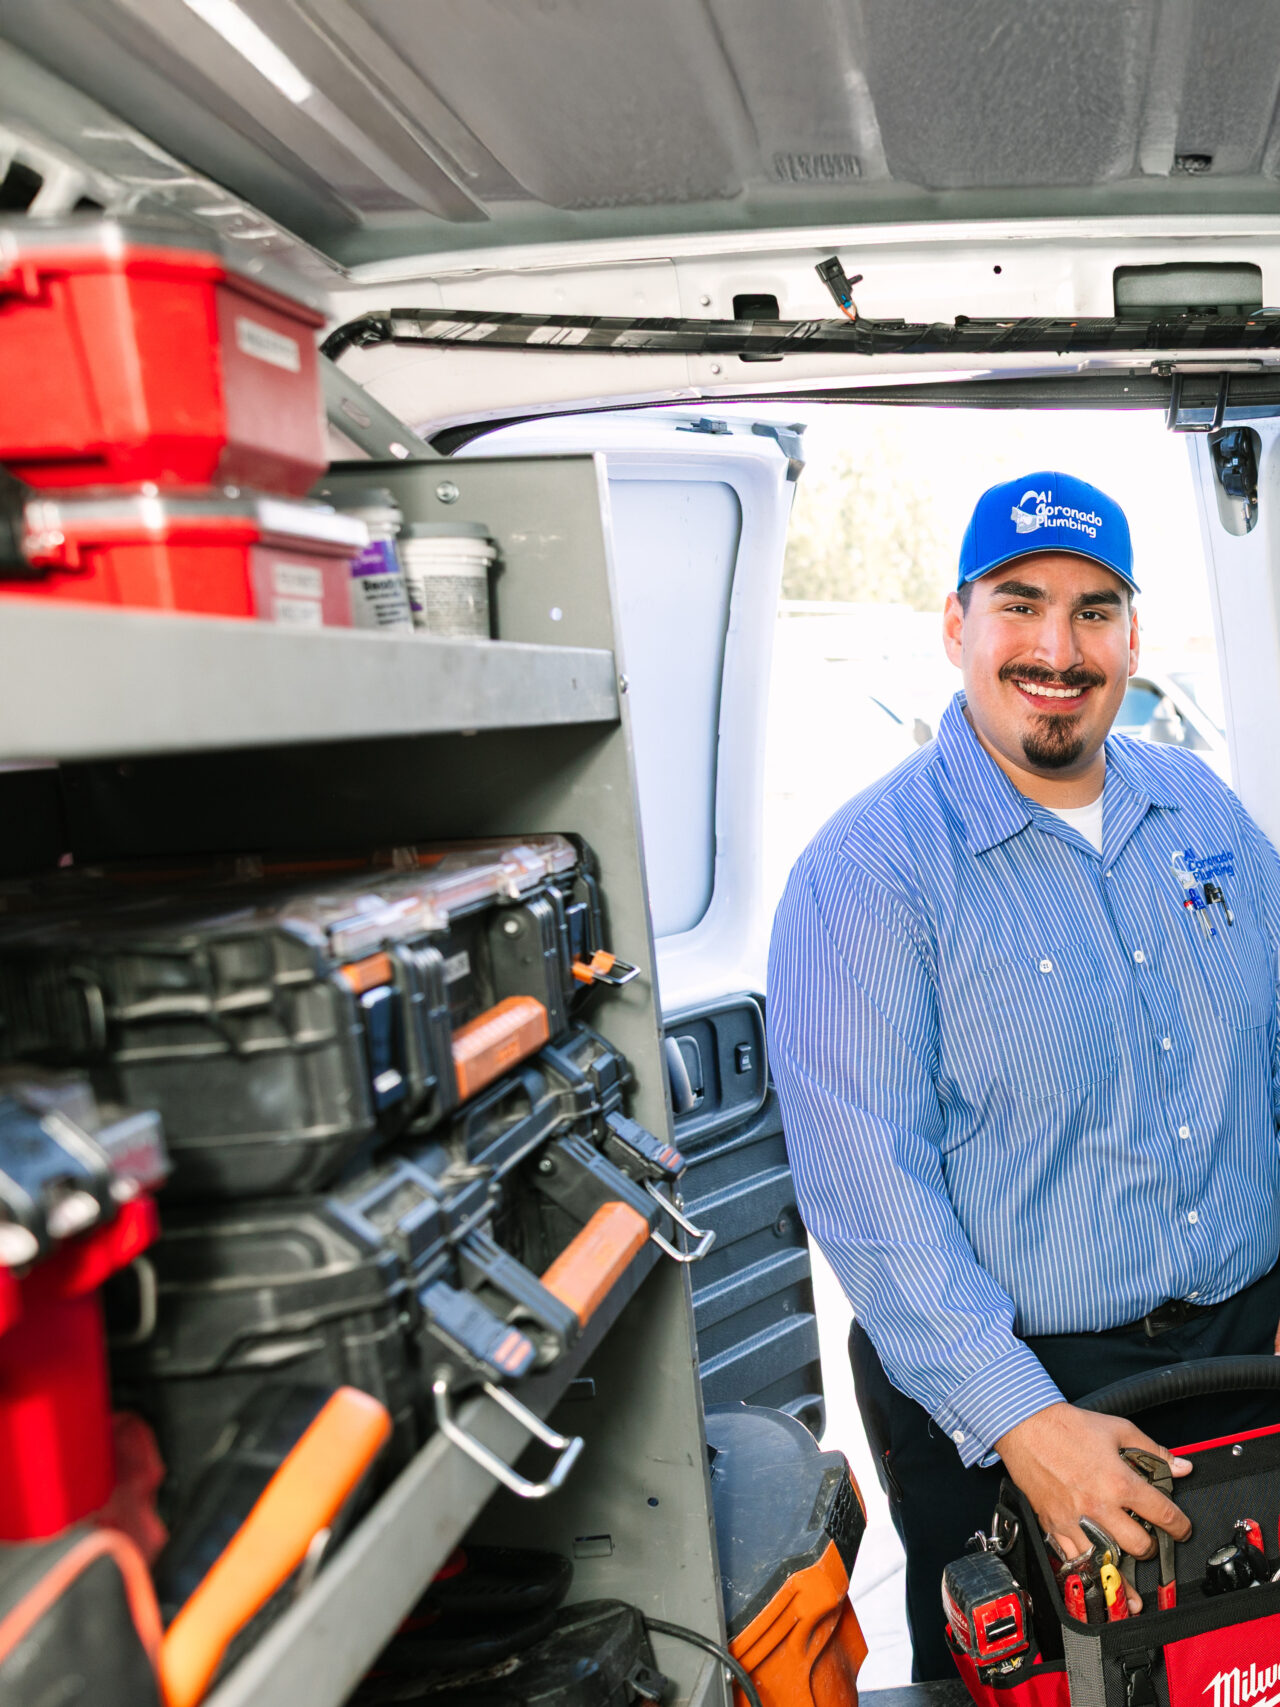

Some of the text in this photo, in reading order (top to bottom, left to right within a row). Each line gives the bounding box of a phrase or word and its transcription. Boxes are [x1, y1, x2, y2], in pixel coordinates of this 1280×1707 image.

[1036, 490, 1052, 503] Al
[1036, 503, 1102, 526] Coronado
[1037, 515, 1096, 538] Plumbing
